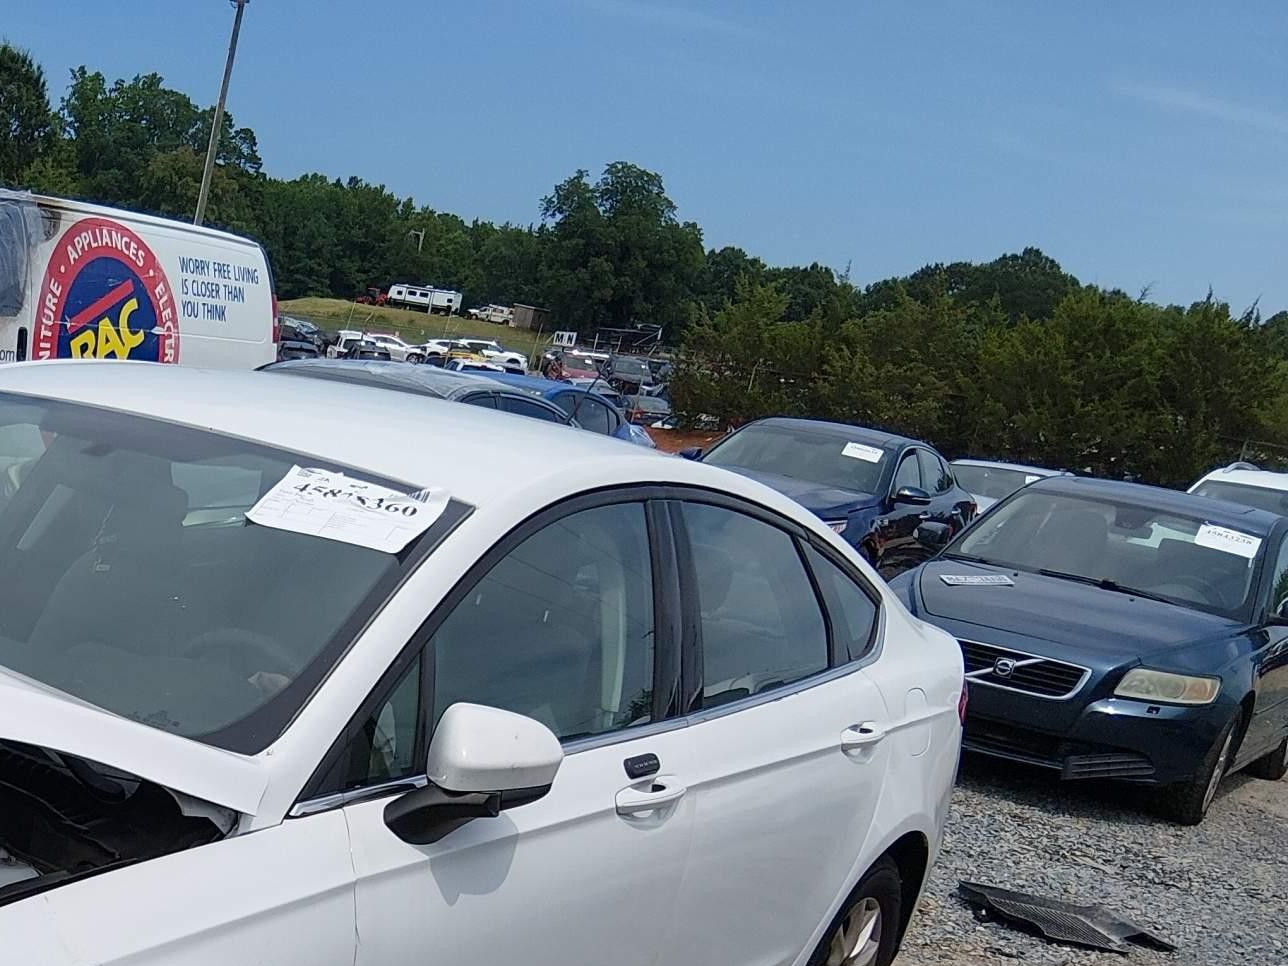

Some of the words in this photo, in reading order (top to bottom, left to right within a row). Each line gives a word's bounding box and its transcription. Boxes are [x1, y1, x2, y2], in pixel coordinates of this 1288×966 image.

[66, 228, 145, 267] APPLIANCES
[179, 256, 209, 277] WORRY
[213, 262, 231, 280] FREE
[233, 265, 259, 284] LIVING
[181, 278, 189, 295] IS
[192, 280, 221, 300] CLOSER
[223, 284, 245, 303] THAN
[181, 300, 199, 319] YOU
[202, 303, 227, 322] THINK
